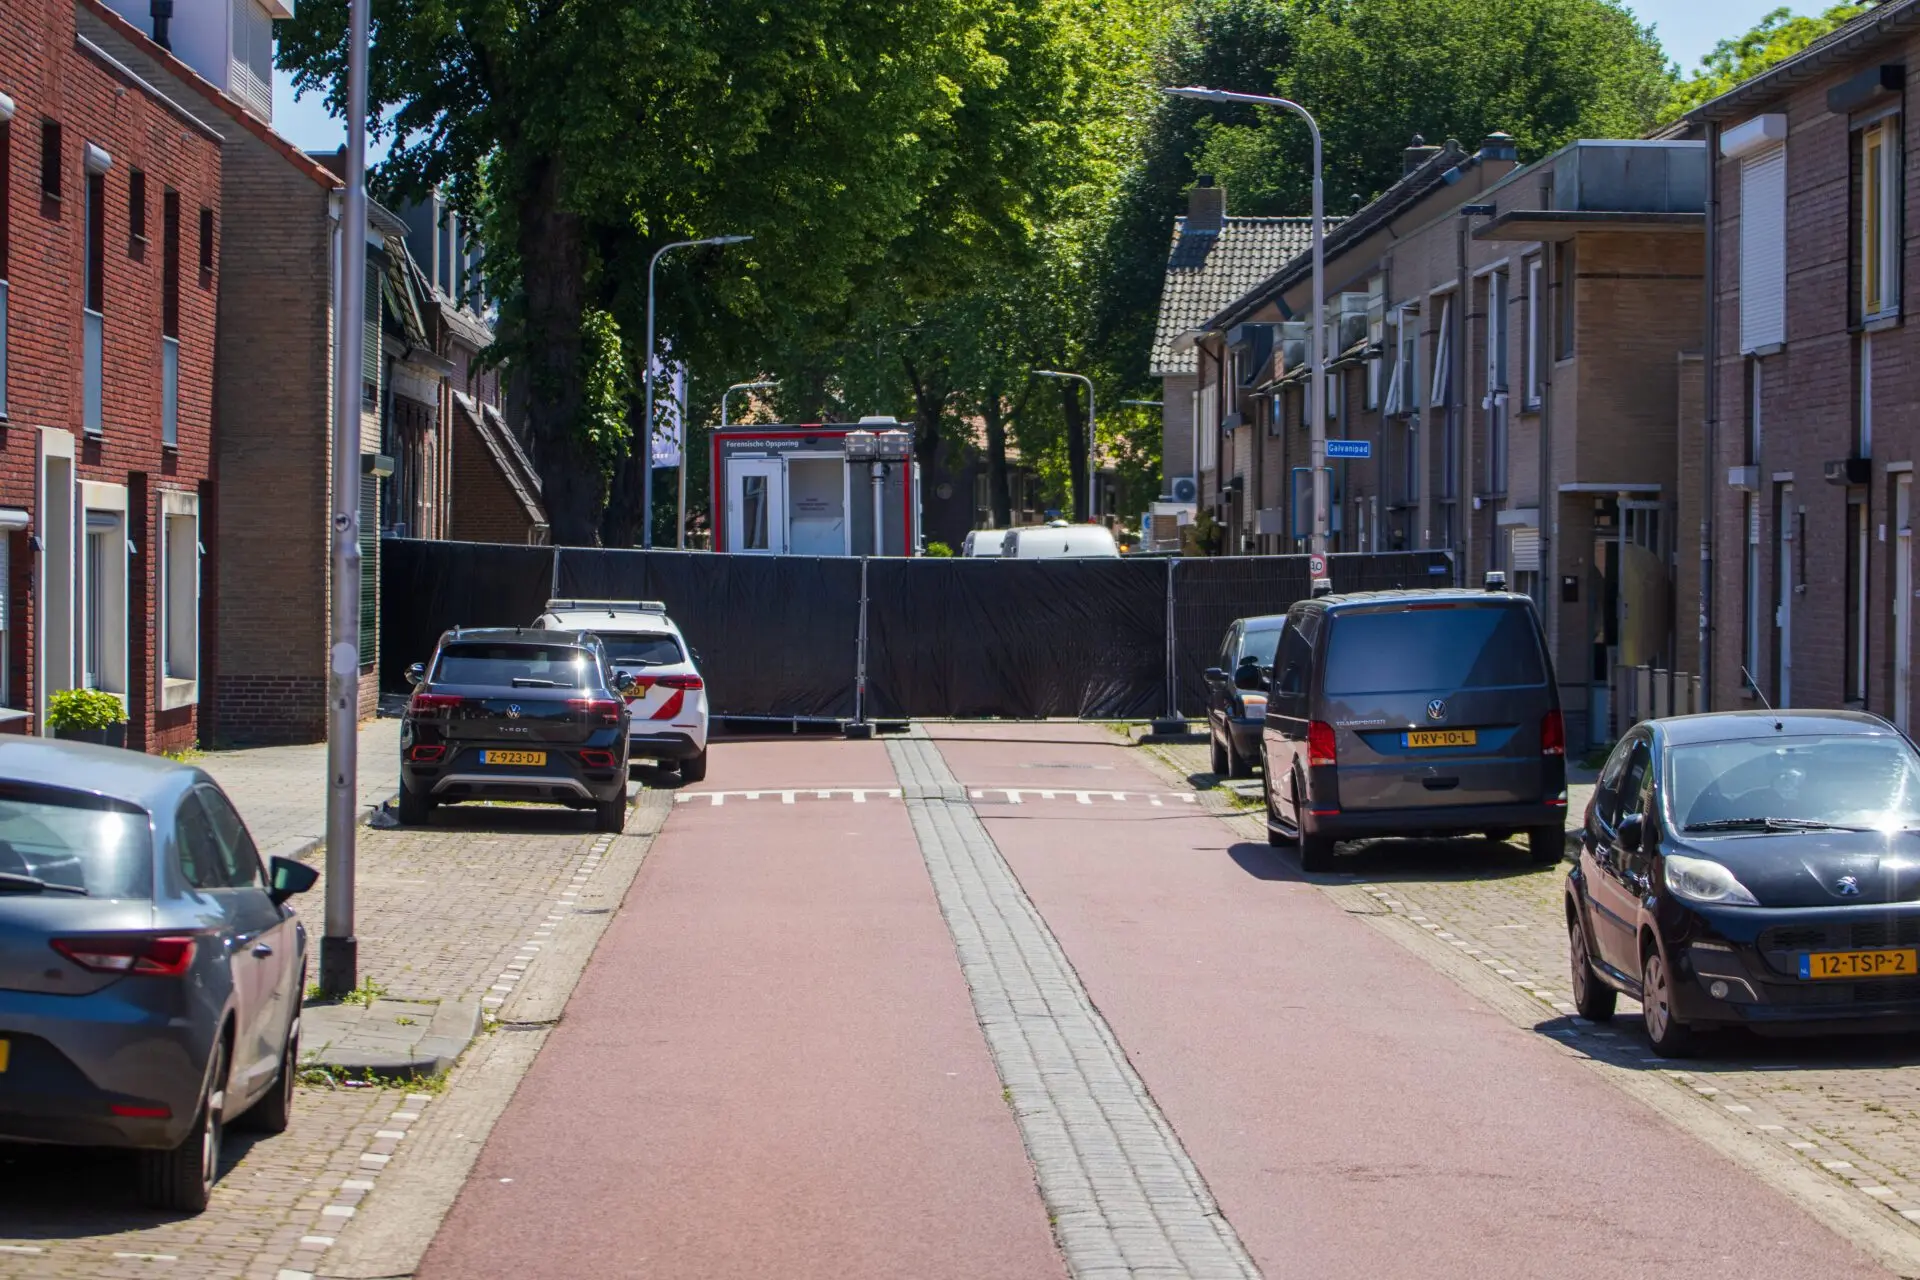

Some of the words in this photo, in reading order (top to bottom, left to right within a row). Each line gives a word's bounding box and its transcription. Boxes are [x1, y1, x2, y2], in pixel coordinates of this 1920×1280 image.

[726, 440, 764, 448] Forensische
[766, 440, 799, 449] Opsporing
[1412, 732, 1469, 745] VRV-10-L
[489, 752, 541, 764] Z-923-DJ
[1820, 953, 1906, 973] 12-TSP-2
